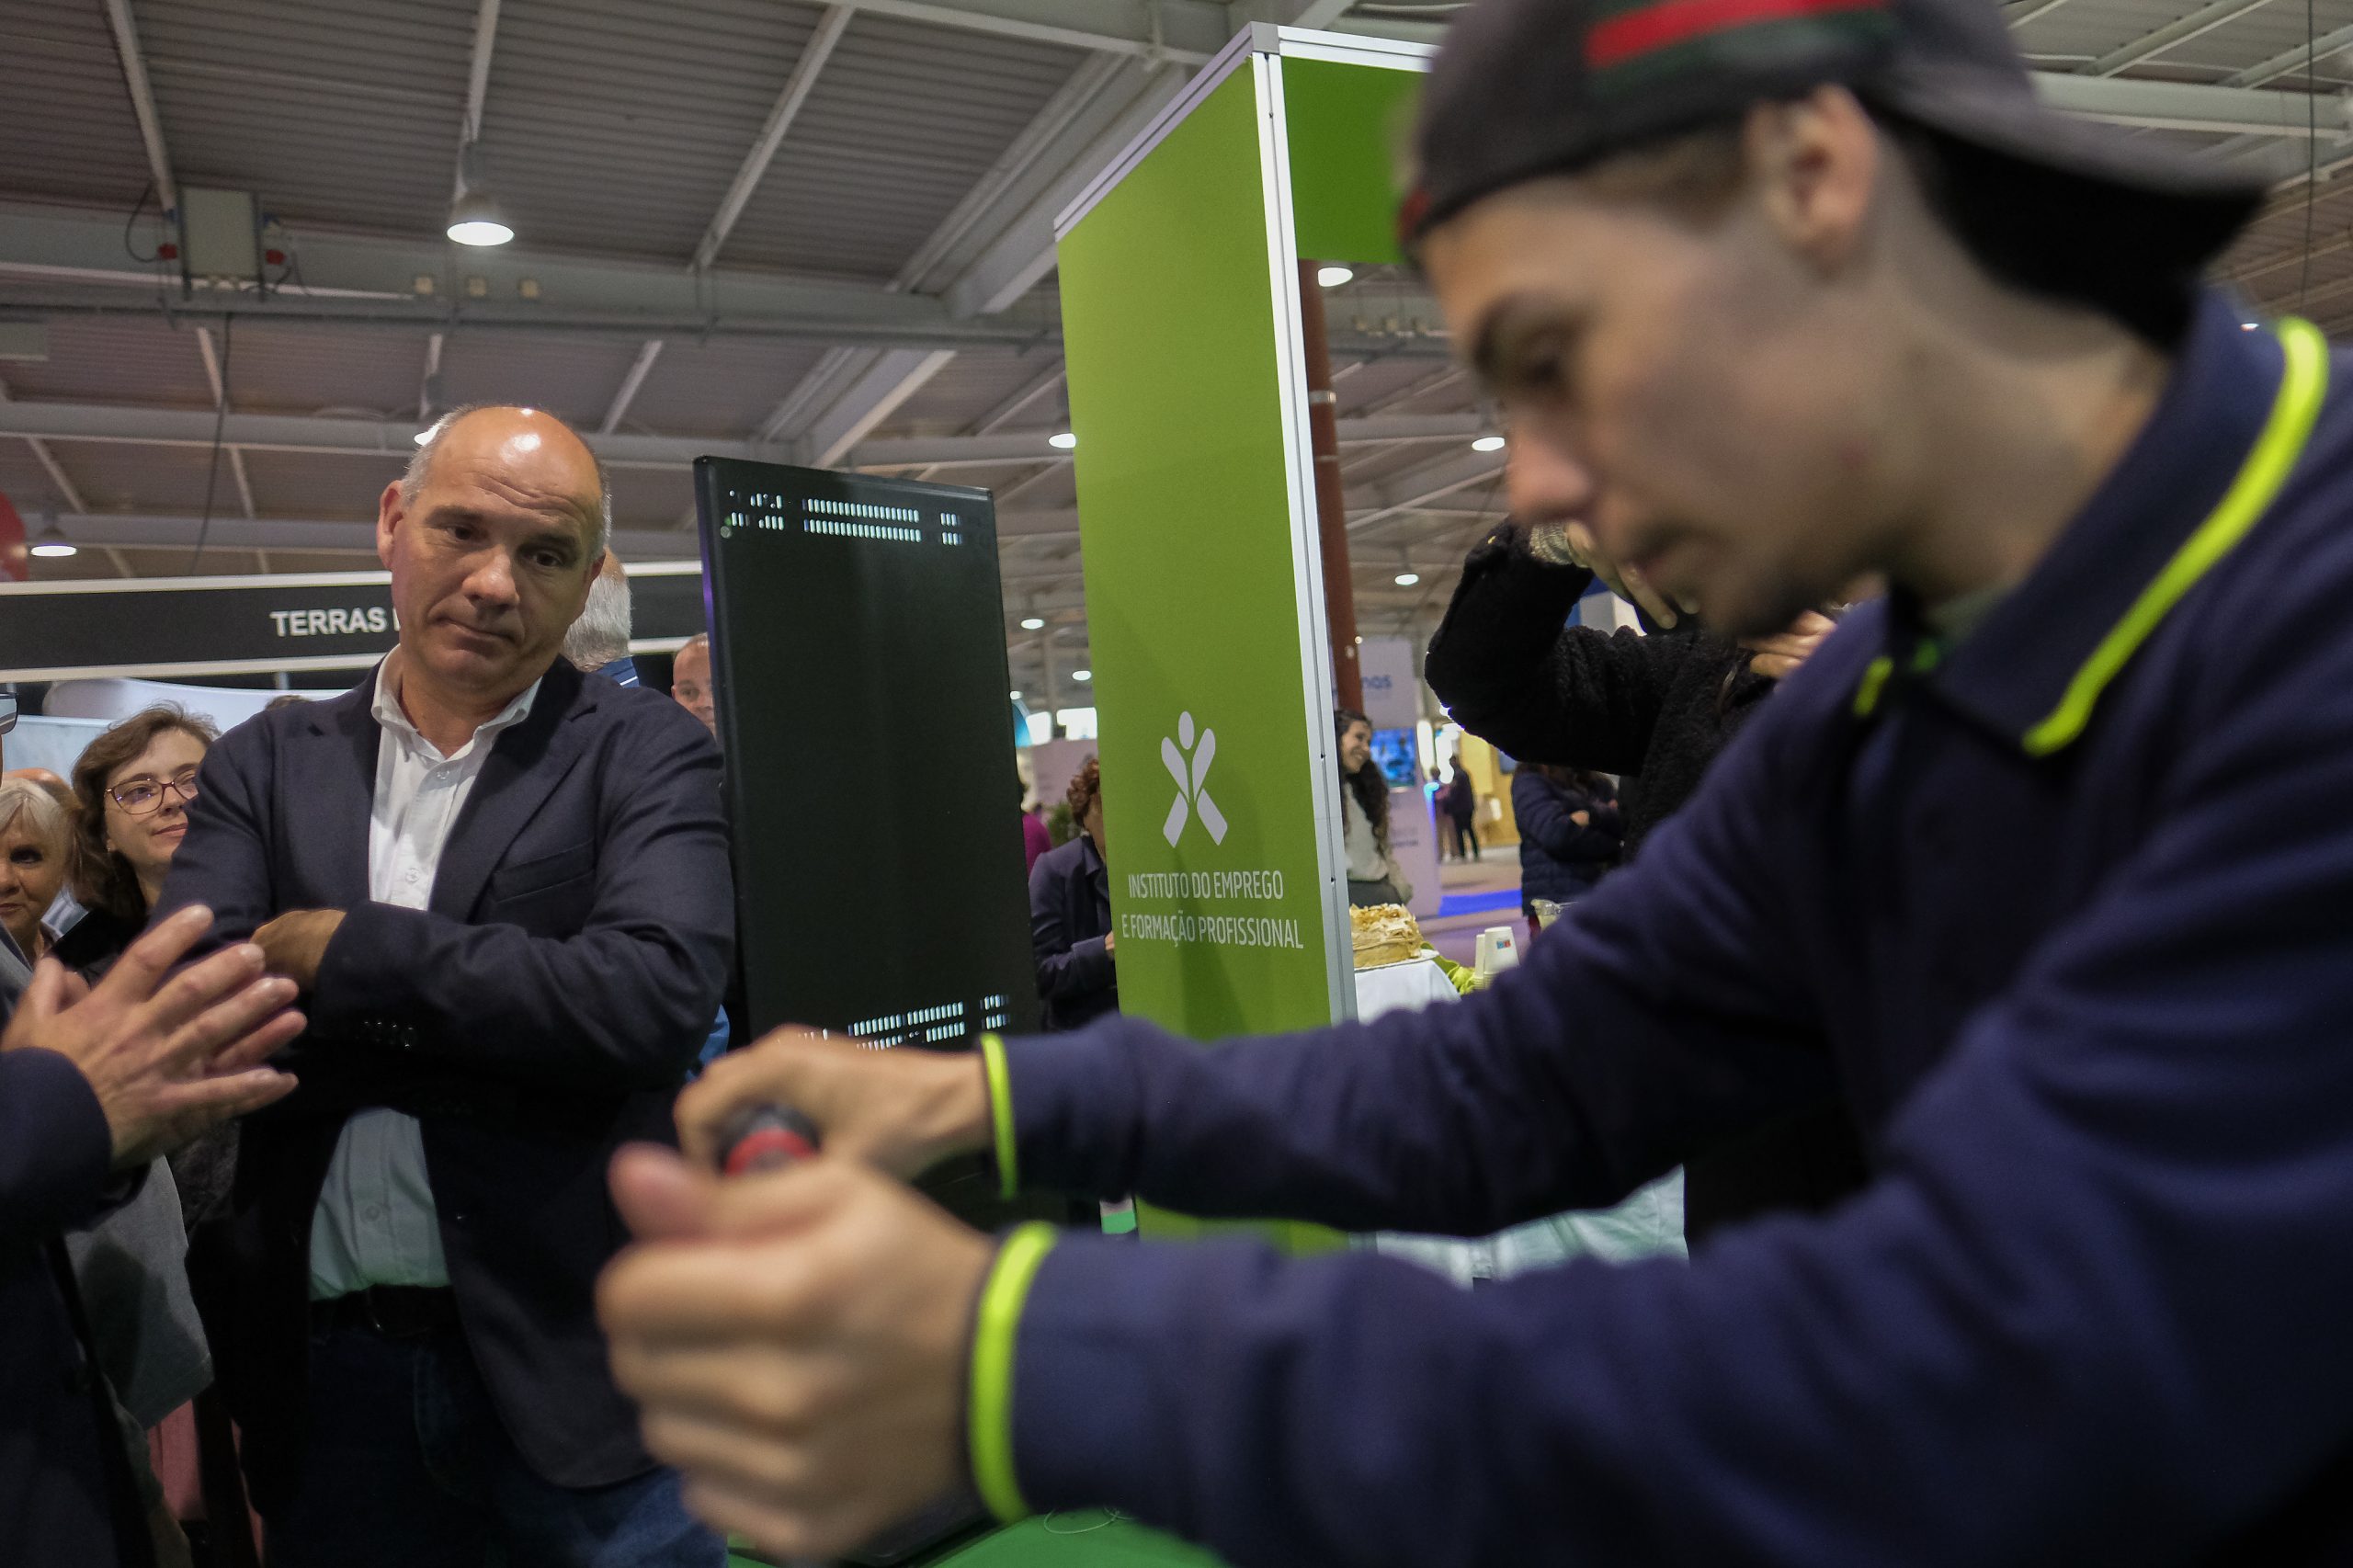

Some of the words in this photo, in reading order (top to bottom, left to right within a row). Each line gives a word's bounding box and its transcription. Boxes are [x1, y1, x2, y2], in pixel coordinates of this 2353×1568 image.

[269, 607, 387, 637] TERRAS
[1128, 872, 1189, 898] INSTITUTO
[1191, 871, 1211, 898] DO
[1213, 870, 1284, 900] EMPREGO
[1121, 914, 1130, 938] E
[1131, 910, 1196, 947] FORMAÇÃO
[1199, 916, 1304, 949] PROFISSIONAL
